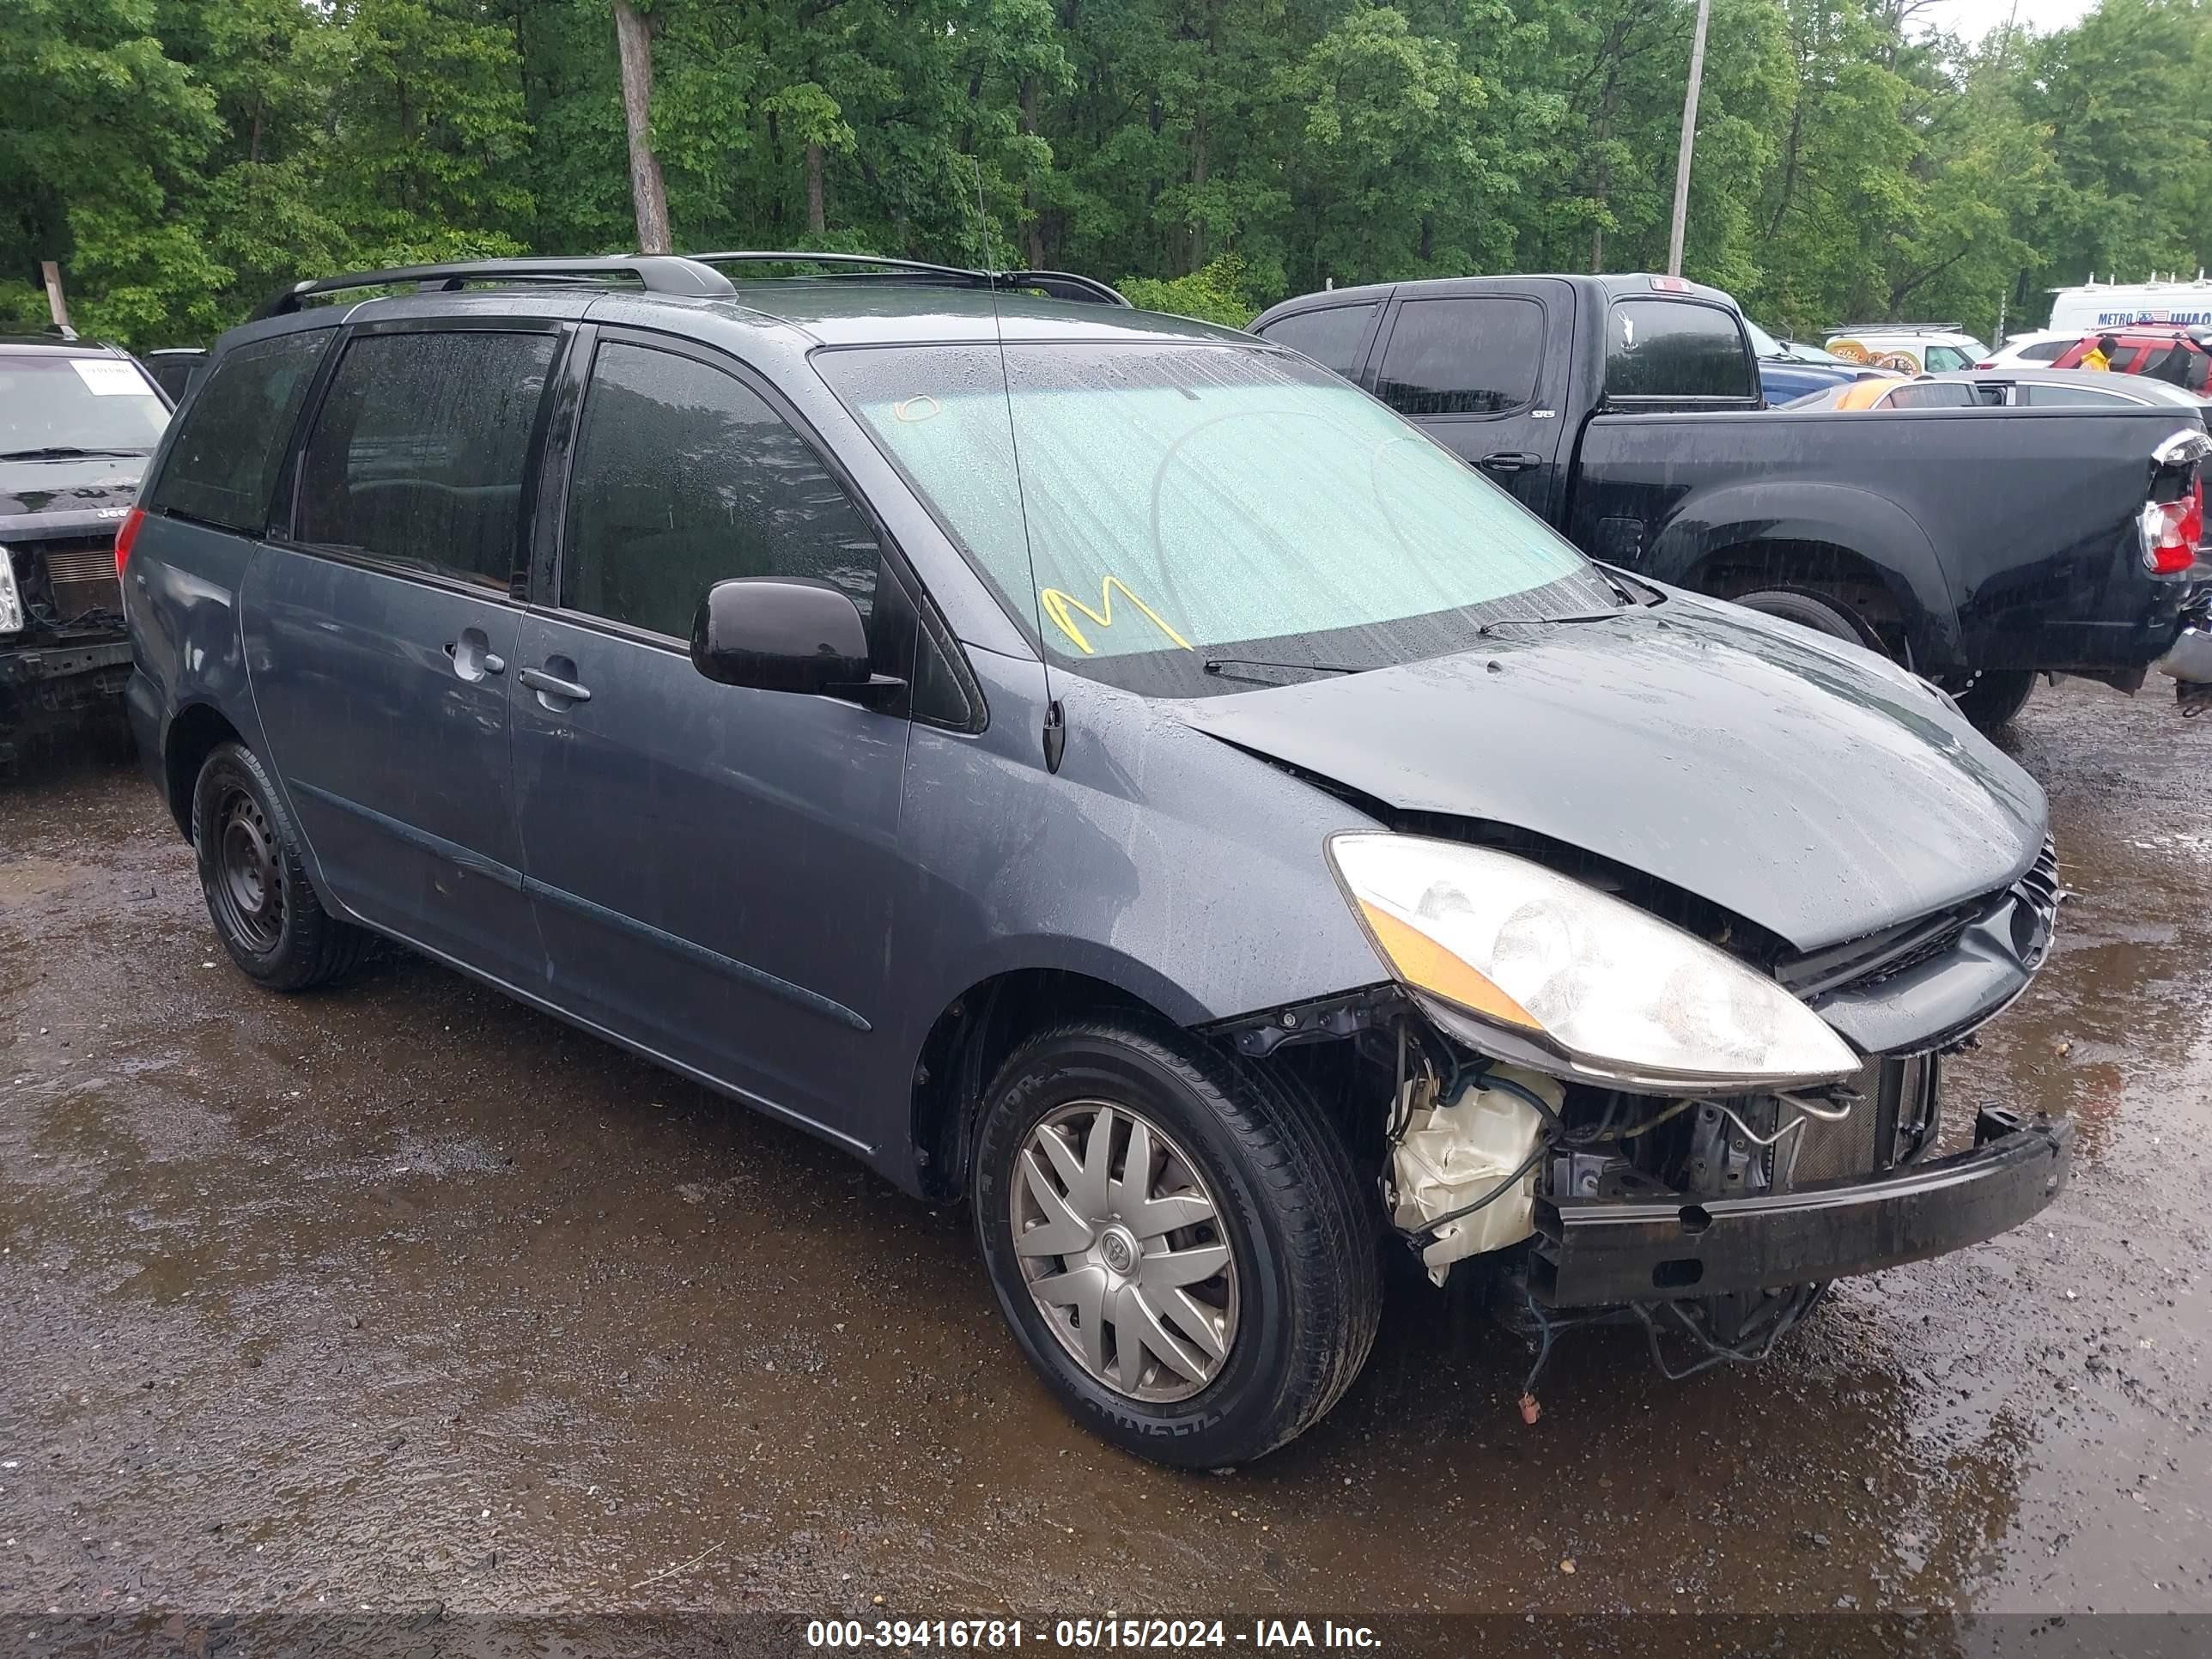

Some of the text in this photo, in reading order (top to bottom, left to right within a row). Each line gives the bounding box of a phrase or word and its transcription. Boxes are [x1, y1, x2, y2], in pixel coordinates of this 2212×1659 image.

[2098, 313, 2134, 325] METRO
[1531, 410, 1556, 419] SR5
[96, 508, 130, 519] Jee
[1041, 574, 1195, 655] M
